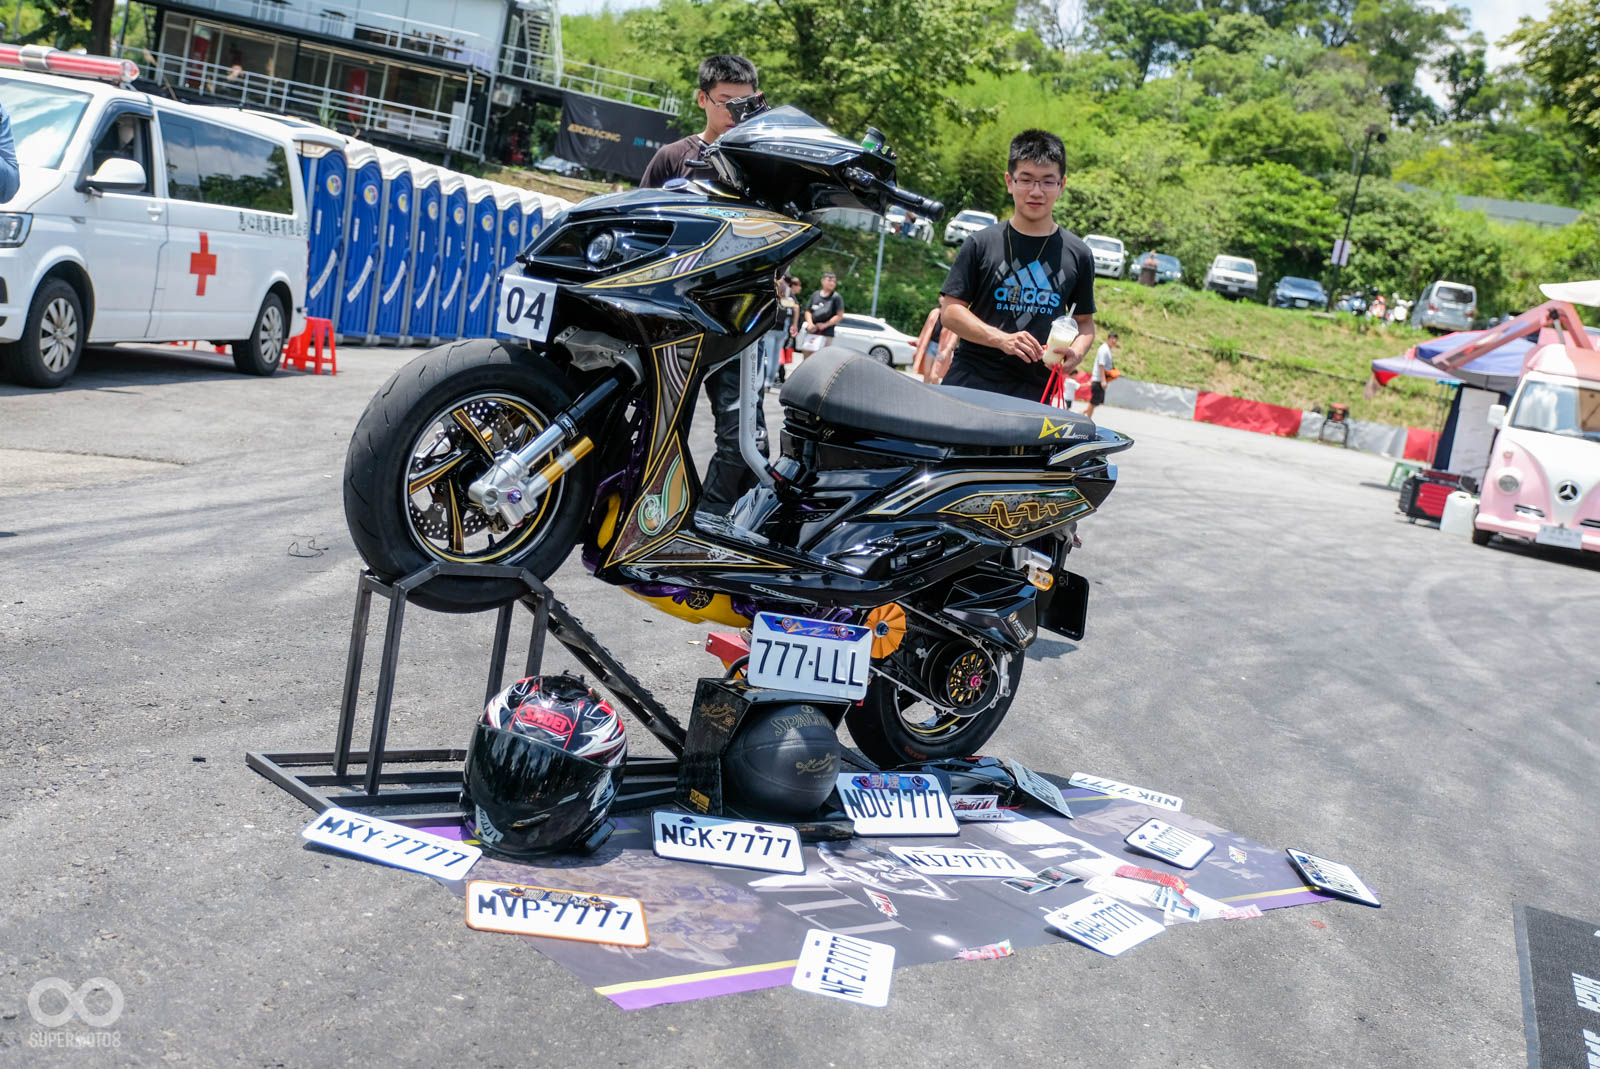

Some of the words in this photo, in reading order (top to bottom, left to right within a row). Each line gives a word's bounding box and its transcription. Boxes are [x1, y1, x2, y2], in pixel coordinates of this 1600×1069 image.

[506, 286, 546, 330] 04
[994, 285, 1061, 308] adidas
[996, 302, 1053, 315] BADMINTON
[757, 638, 864, 687] 777-LLL
[524, 706, 569, 732] SHOEI
[843, 789, 943, 818] NDU-7777
[316, 816, 470, 867] MXY-7777
[661, 823, 792, 858] NGK-7777
[478, 893, 633, 931] MVP-7777
[819, 936, 872, 998] NFZ-7777
